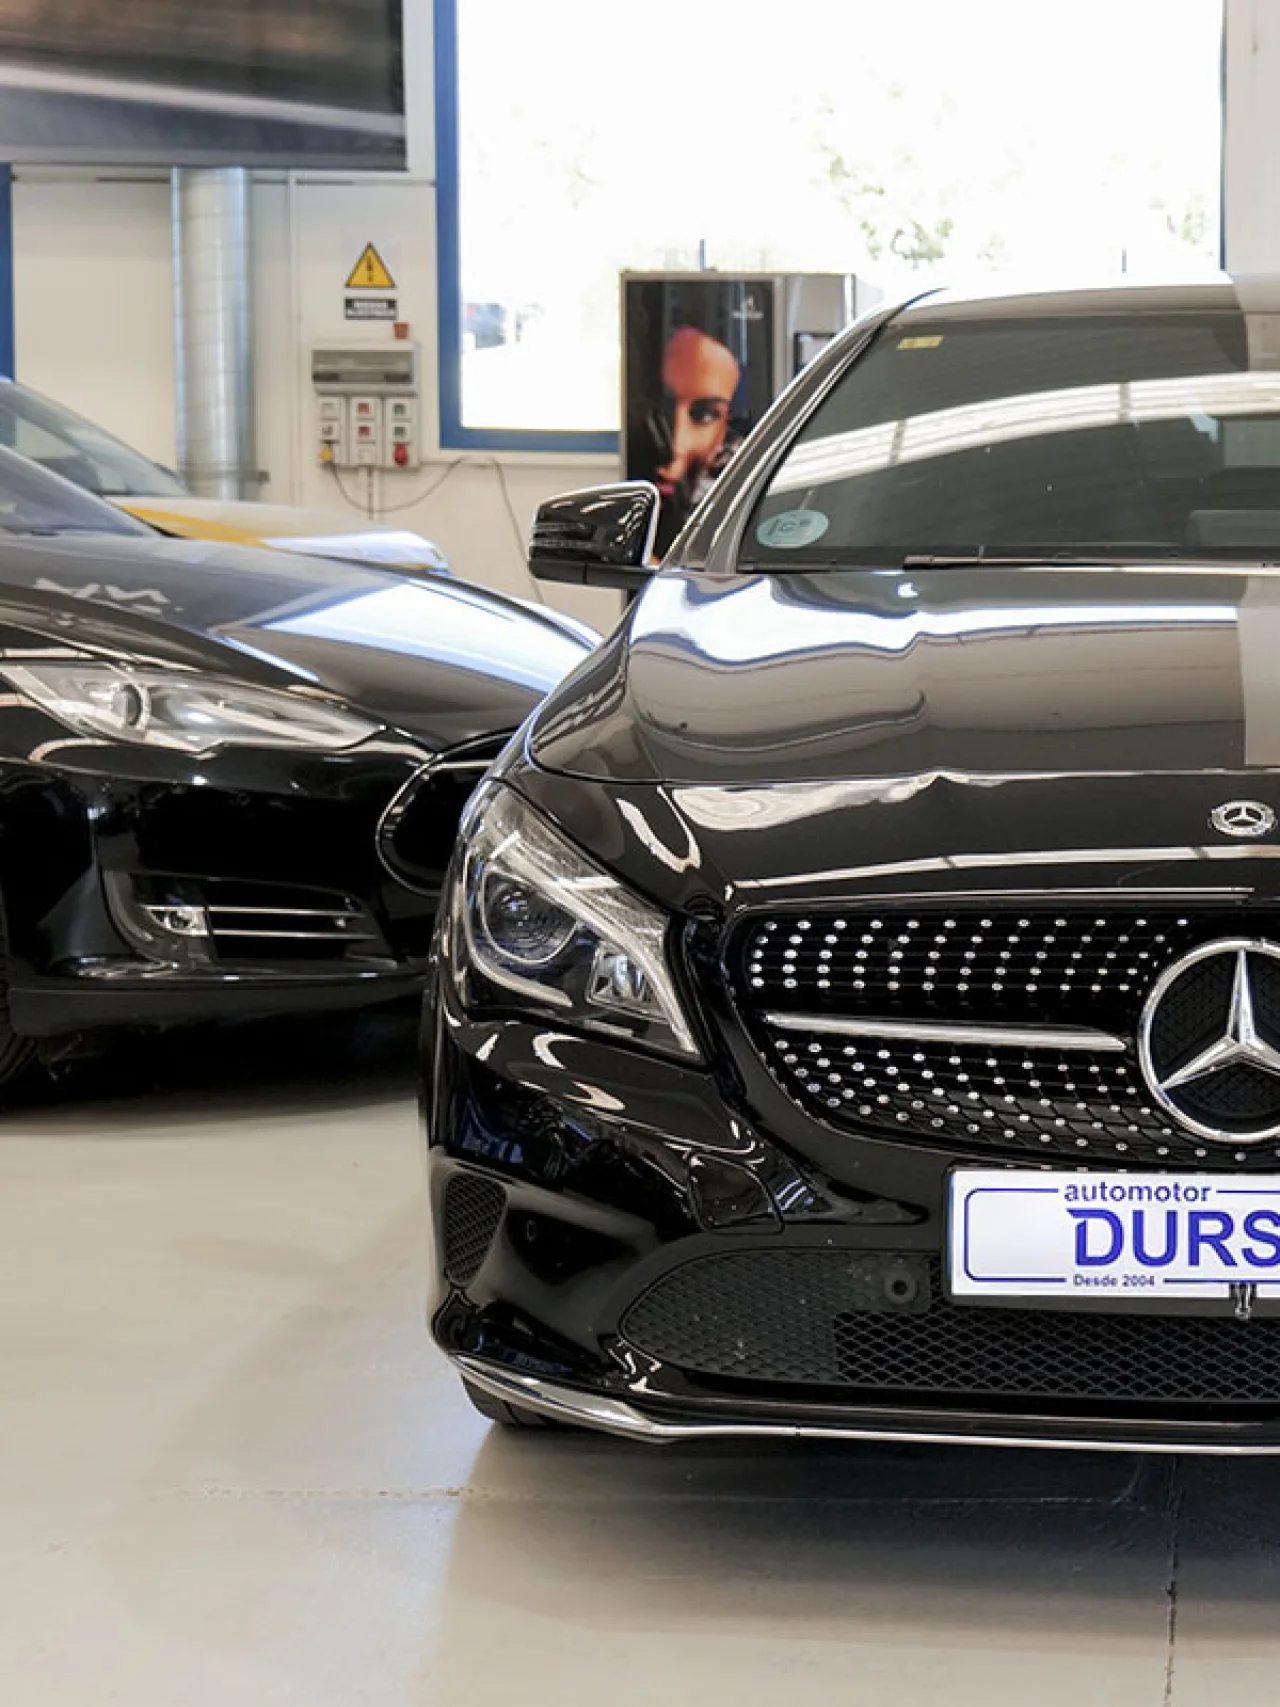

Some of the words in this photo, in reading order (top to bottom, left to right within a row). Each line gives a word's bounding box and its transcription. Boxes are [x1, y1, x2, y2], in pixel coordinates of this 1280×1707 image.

[1064, 1181, 1211, 1202] automotor
[1073, 1274, 1118, 1287] Desde
[1122, 1274, 1155, 1287] 2004
